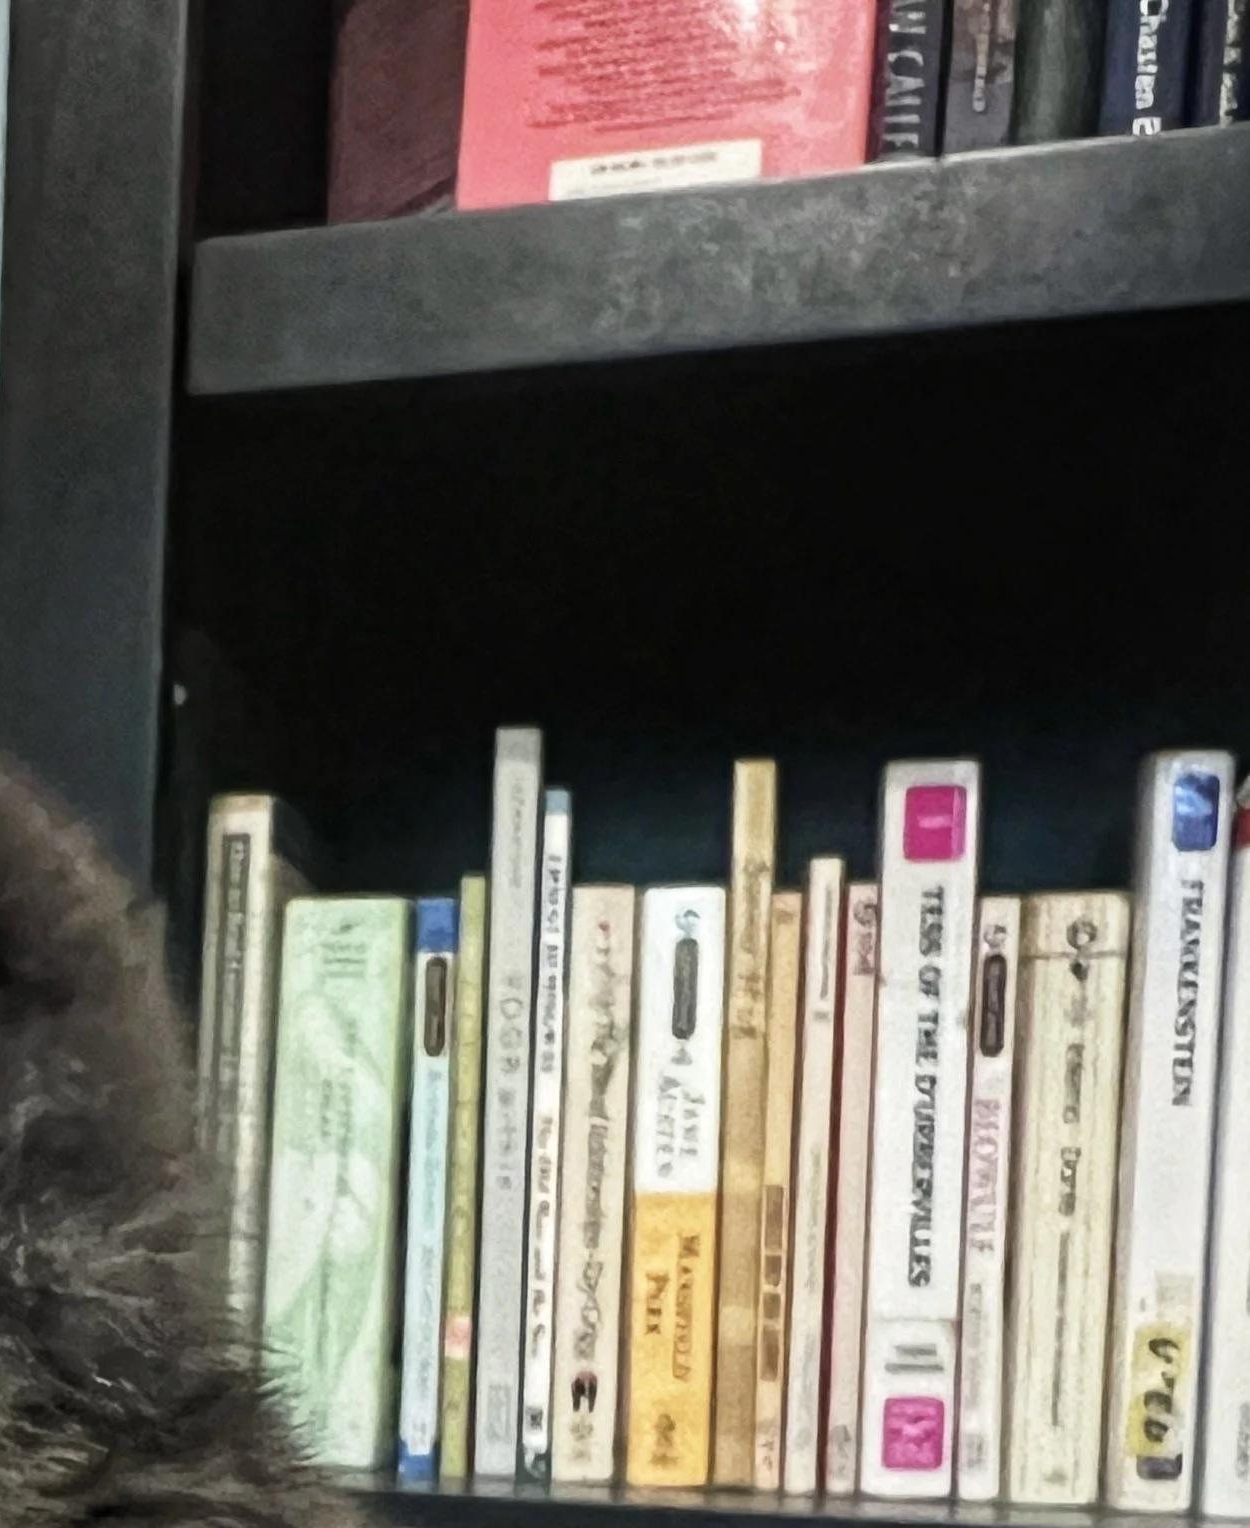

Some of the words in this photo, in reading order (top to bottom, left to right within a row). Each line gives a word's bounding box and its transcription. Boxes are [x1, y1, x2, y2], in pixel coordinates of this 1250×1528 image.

[920, 886, 946, 957] TESS
[919, 964, 943, 999] OF
[1171, 878, 1204, 1108] FRANKENSTEIN
[915, 1011, 940, 1066] THE
